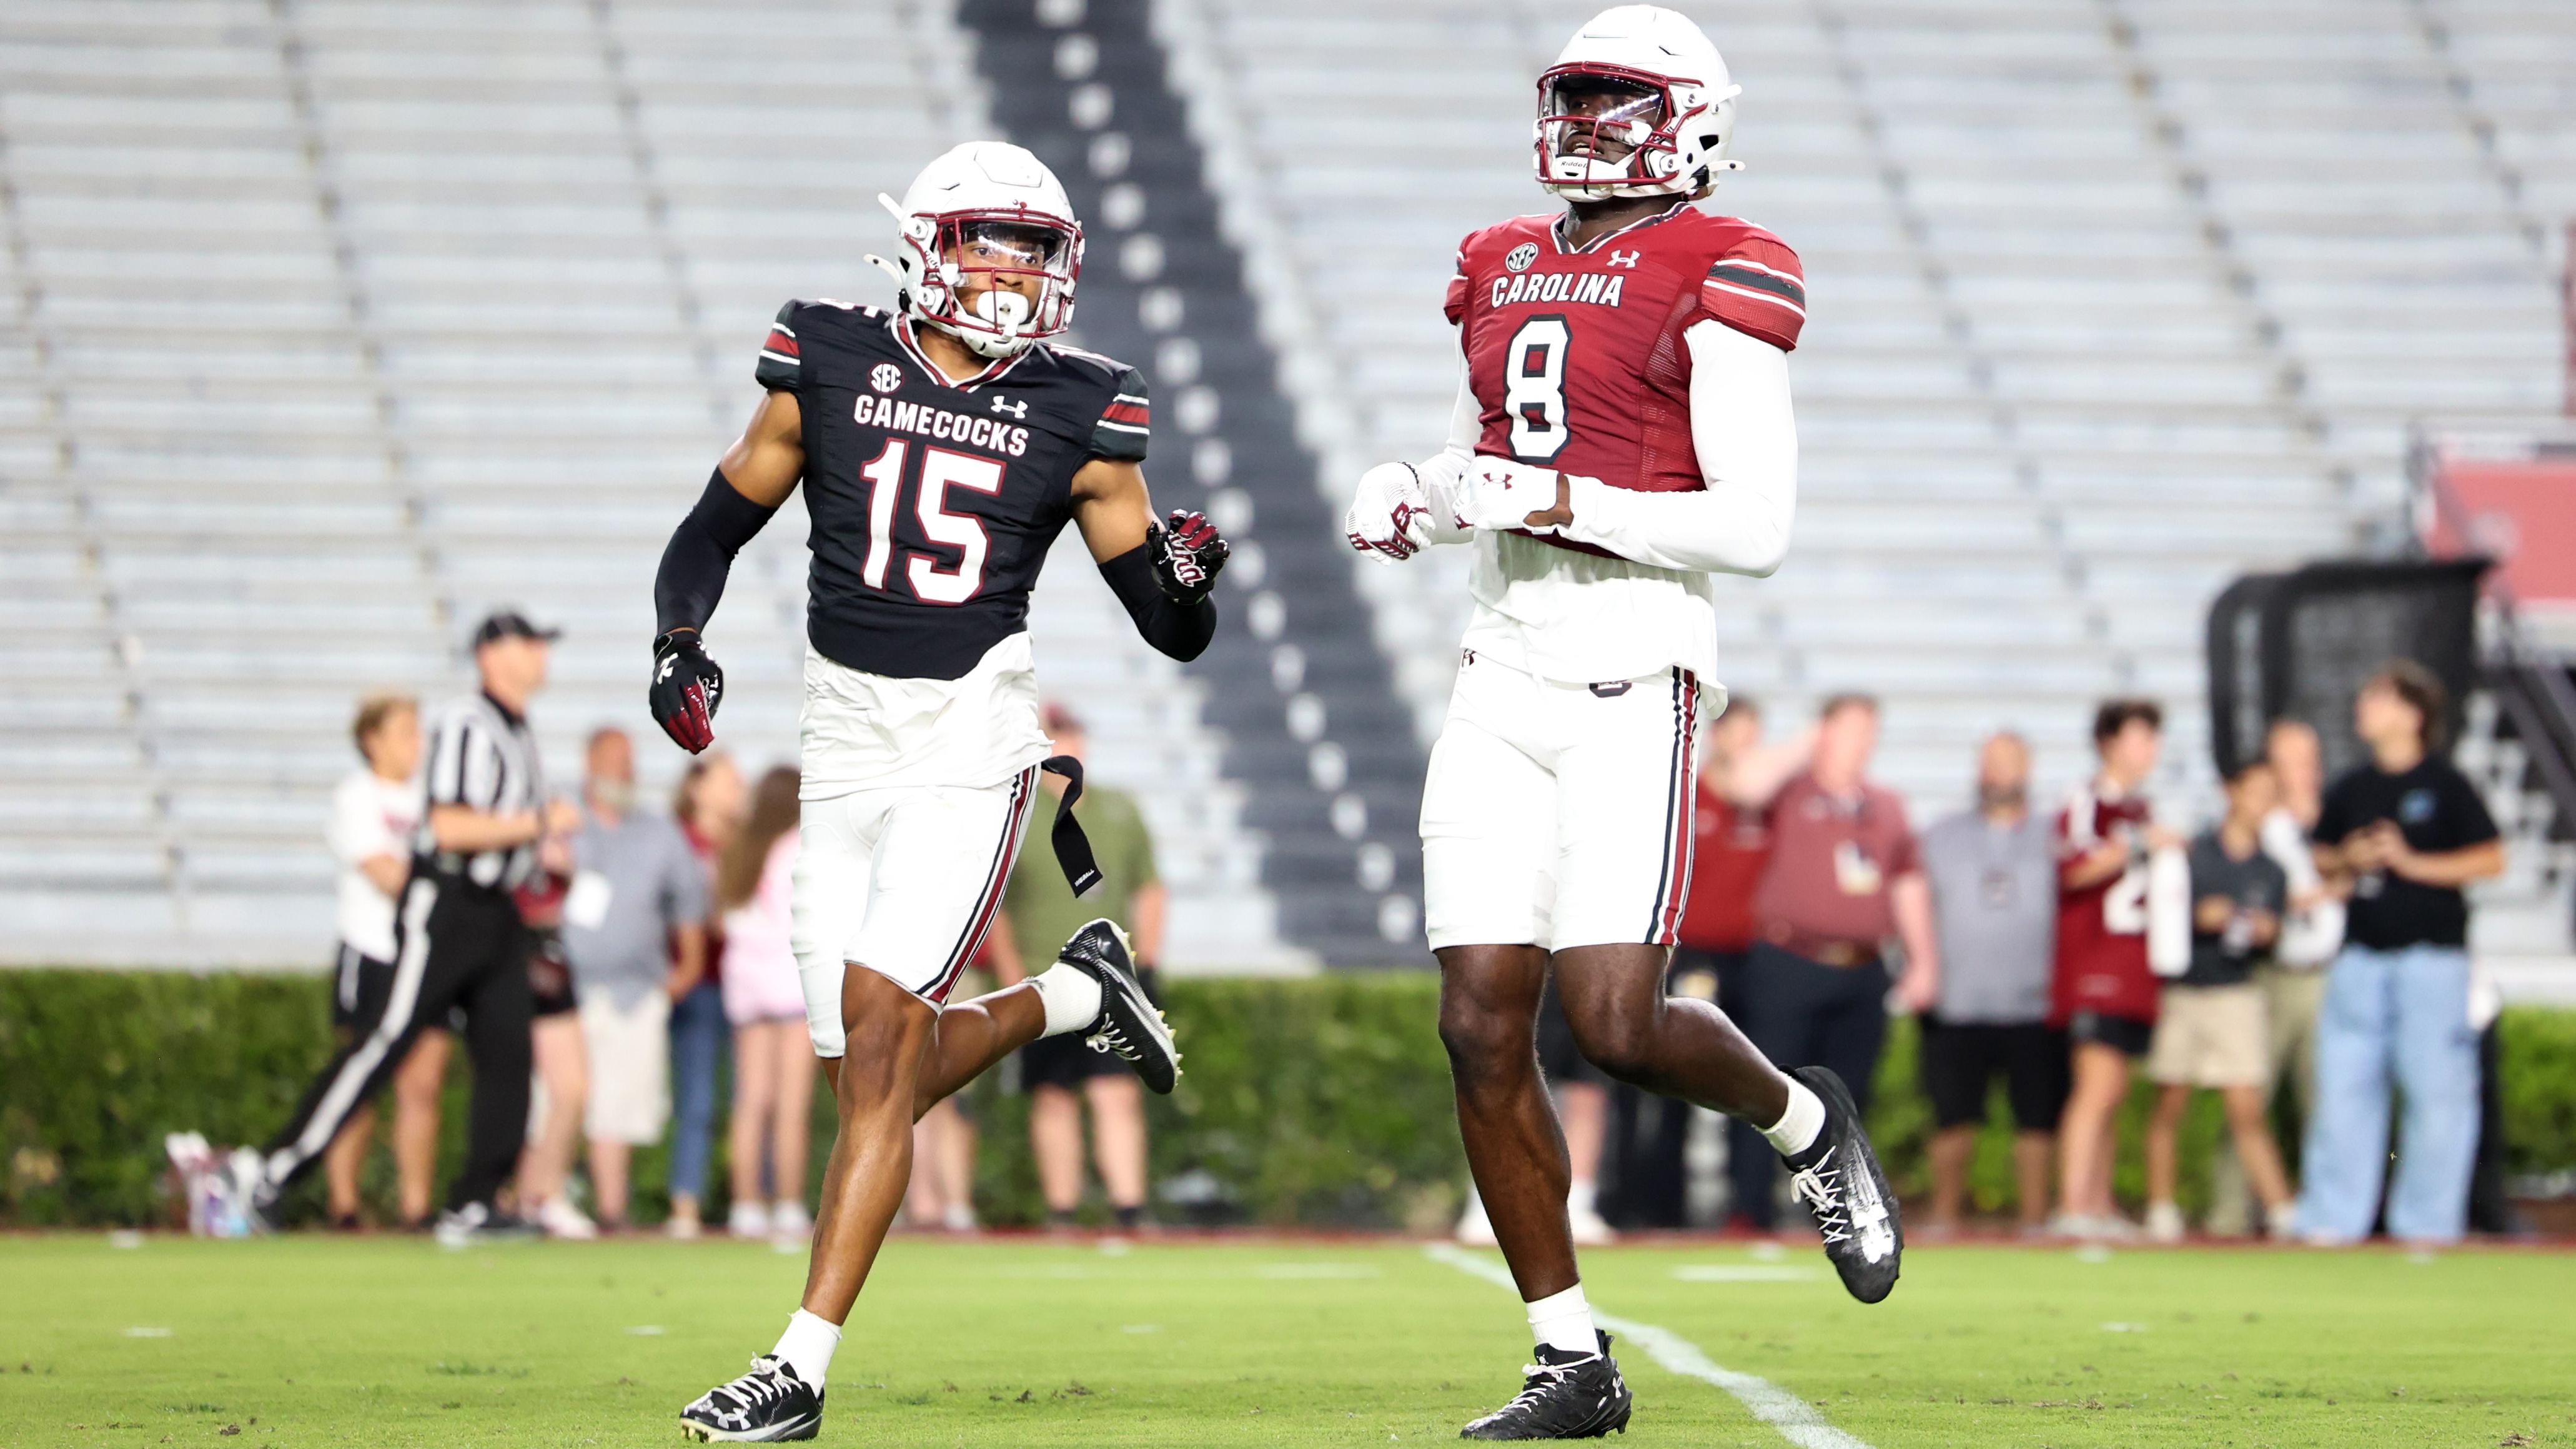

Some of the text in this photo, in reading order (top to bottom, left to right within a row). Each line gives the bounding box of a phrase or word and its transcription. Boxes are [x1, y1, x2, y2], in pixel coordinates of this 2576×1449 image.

[1560, 161, 1588, 169] Riddel
[1507, 244, 1537, 271] SEC
[1491, 273, 1625, 309] CAROLINA
[871, 363, 901, 393] SEC
[1503, 314, 1573, 465] 8
[854, 394, 1029, 457] GAMECOCKS
[859, 436, 1007, 605] 15
